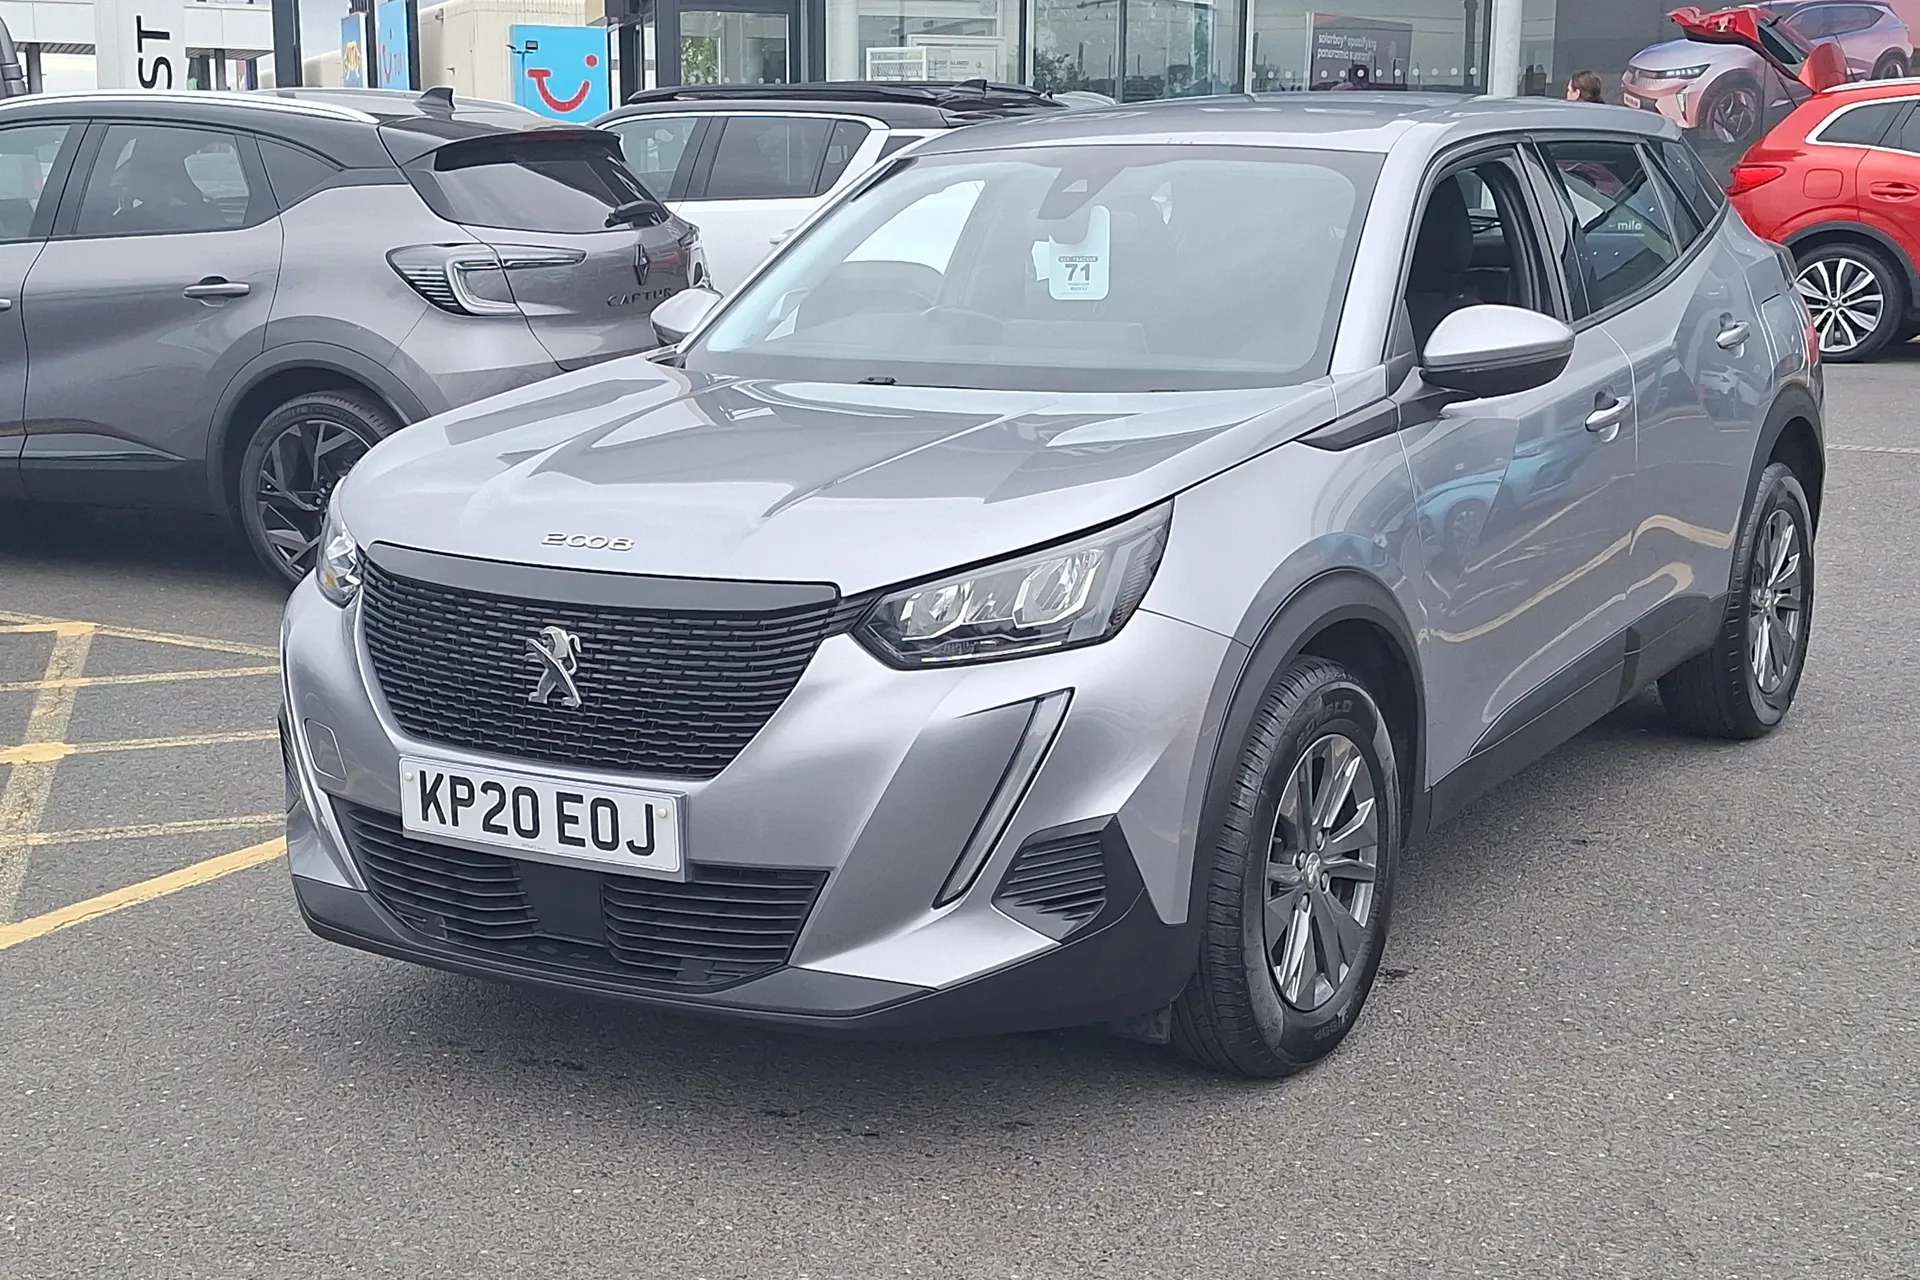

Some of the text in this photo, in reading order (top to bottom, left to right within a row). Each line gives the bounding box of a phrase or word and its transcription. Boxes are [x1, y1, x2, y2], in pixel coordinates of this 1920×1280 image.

[1064, 263, 1090, 281] 71
[607, 287, 673, 307] CAPTUR
[541, 532, 635, 551] 2008
[419, 769, 656, 856] KP20 EOJ
